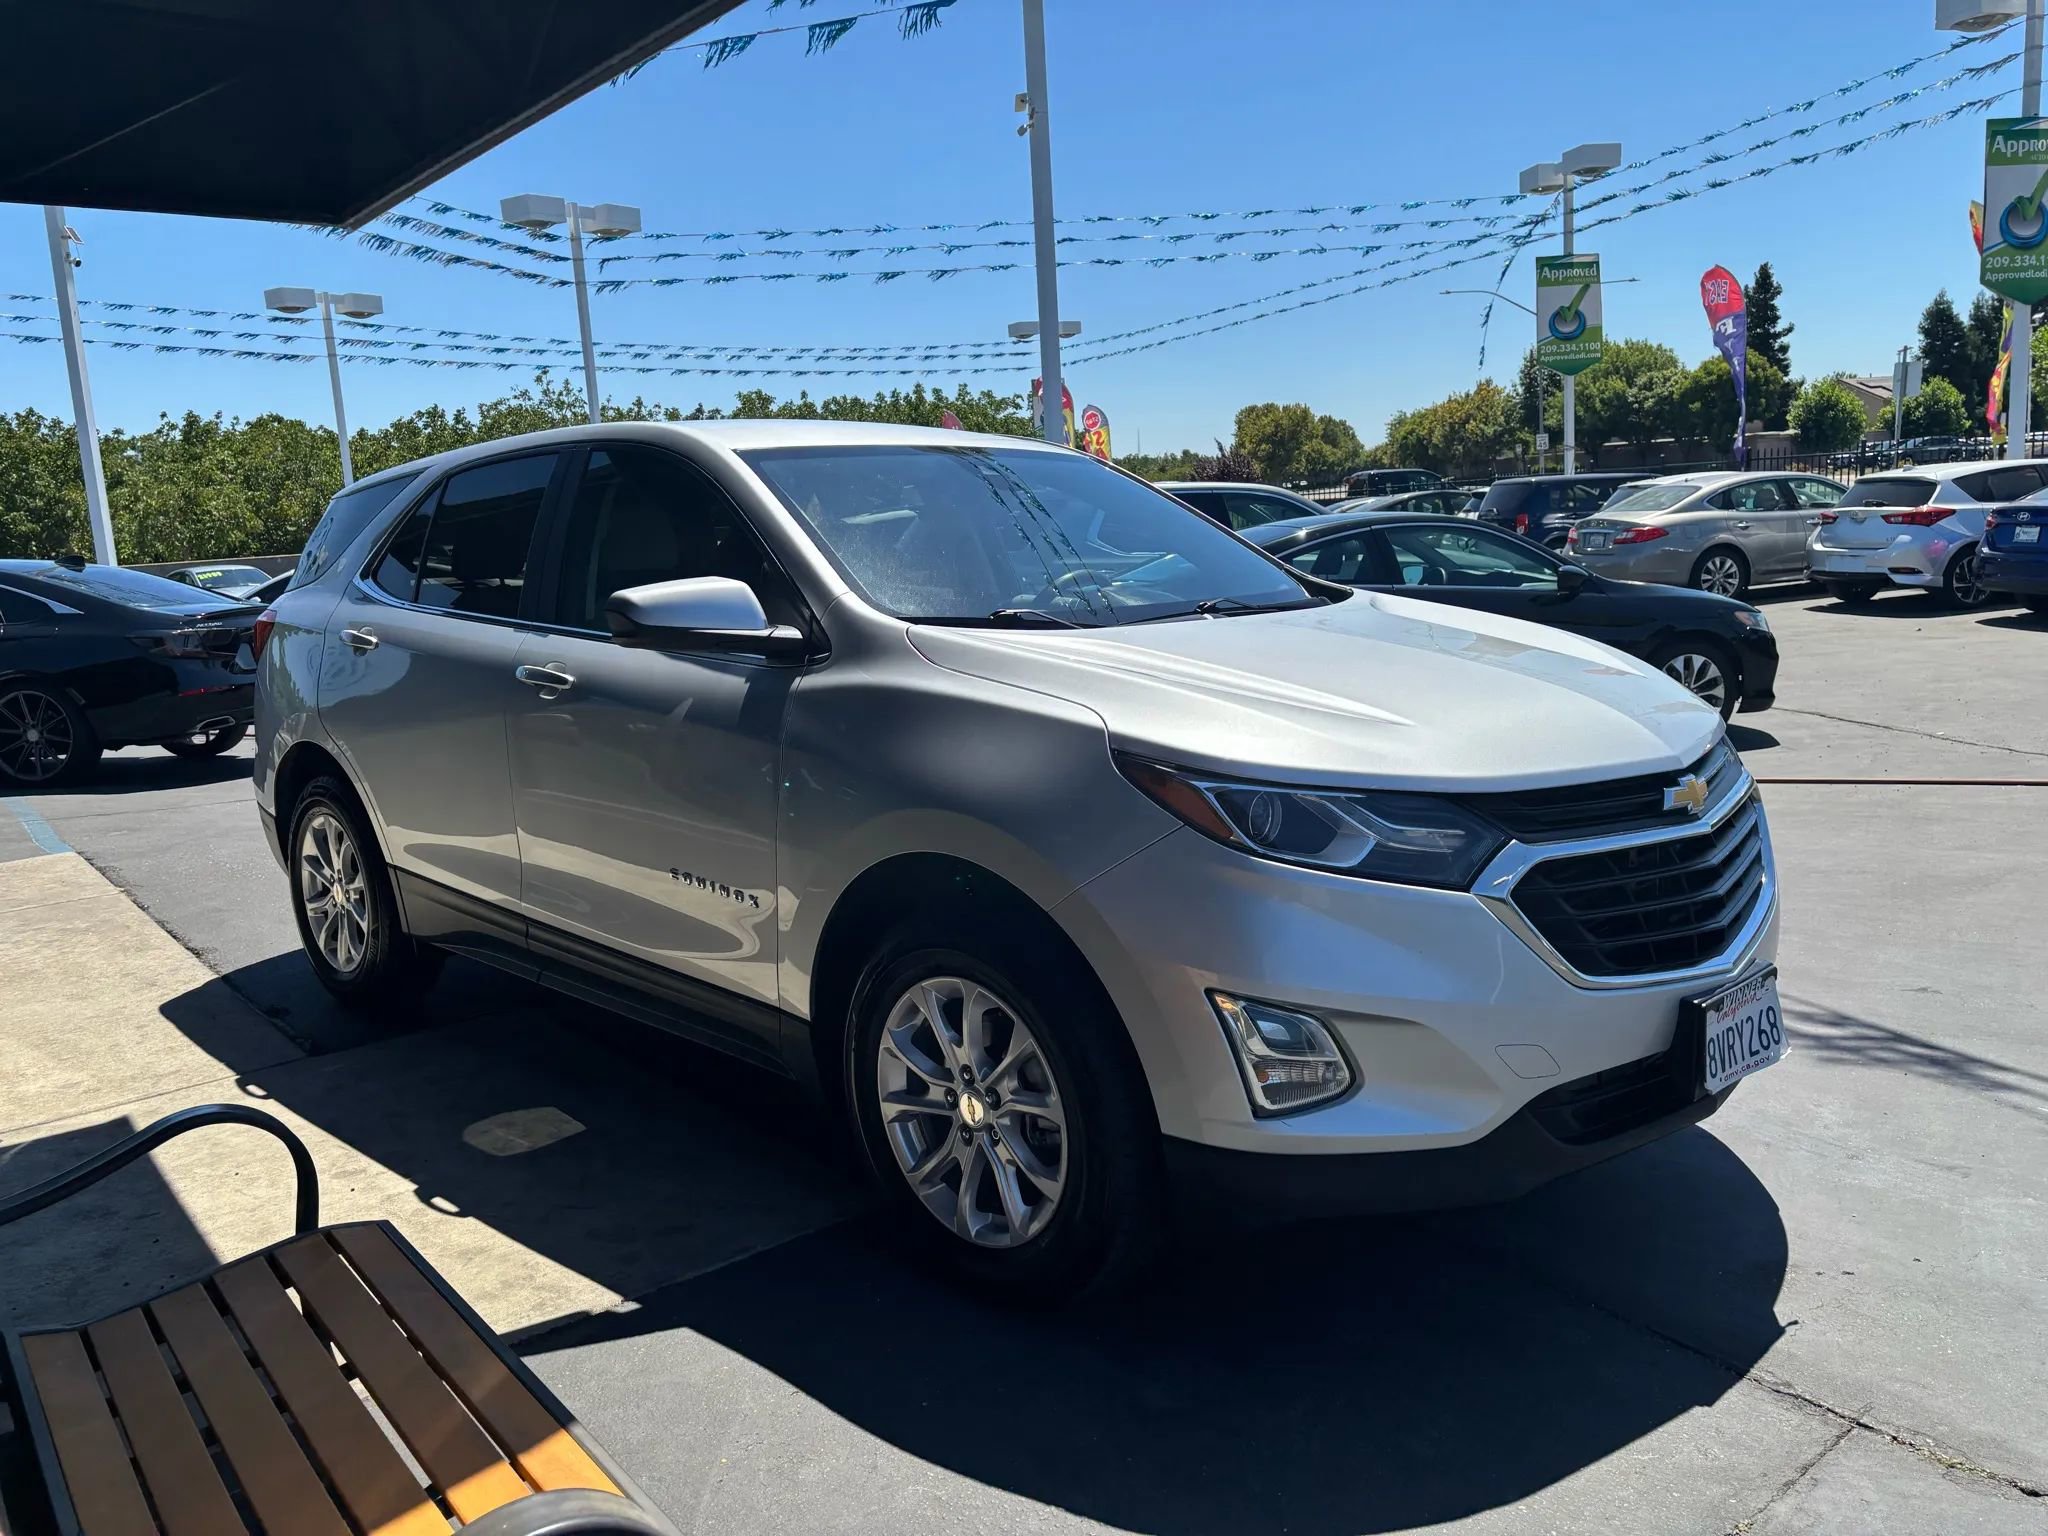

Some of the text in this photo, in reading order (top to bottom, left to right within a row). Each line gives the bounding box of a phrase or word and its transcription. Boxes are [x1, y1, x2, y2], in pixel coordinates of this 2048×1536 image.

[1984, 254, 2048, 268] 209.334.1
[1540, 341, 1600, 354] 209.334.1100
[669, 867, 760, 909] EQUINOX
[1707, 1005, 1781, 1079] 8VRY268
[1724, 1055, 1770, 1082] dmv.ca.gov
